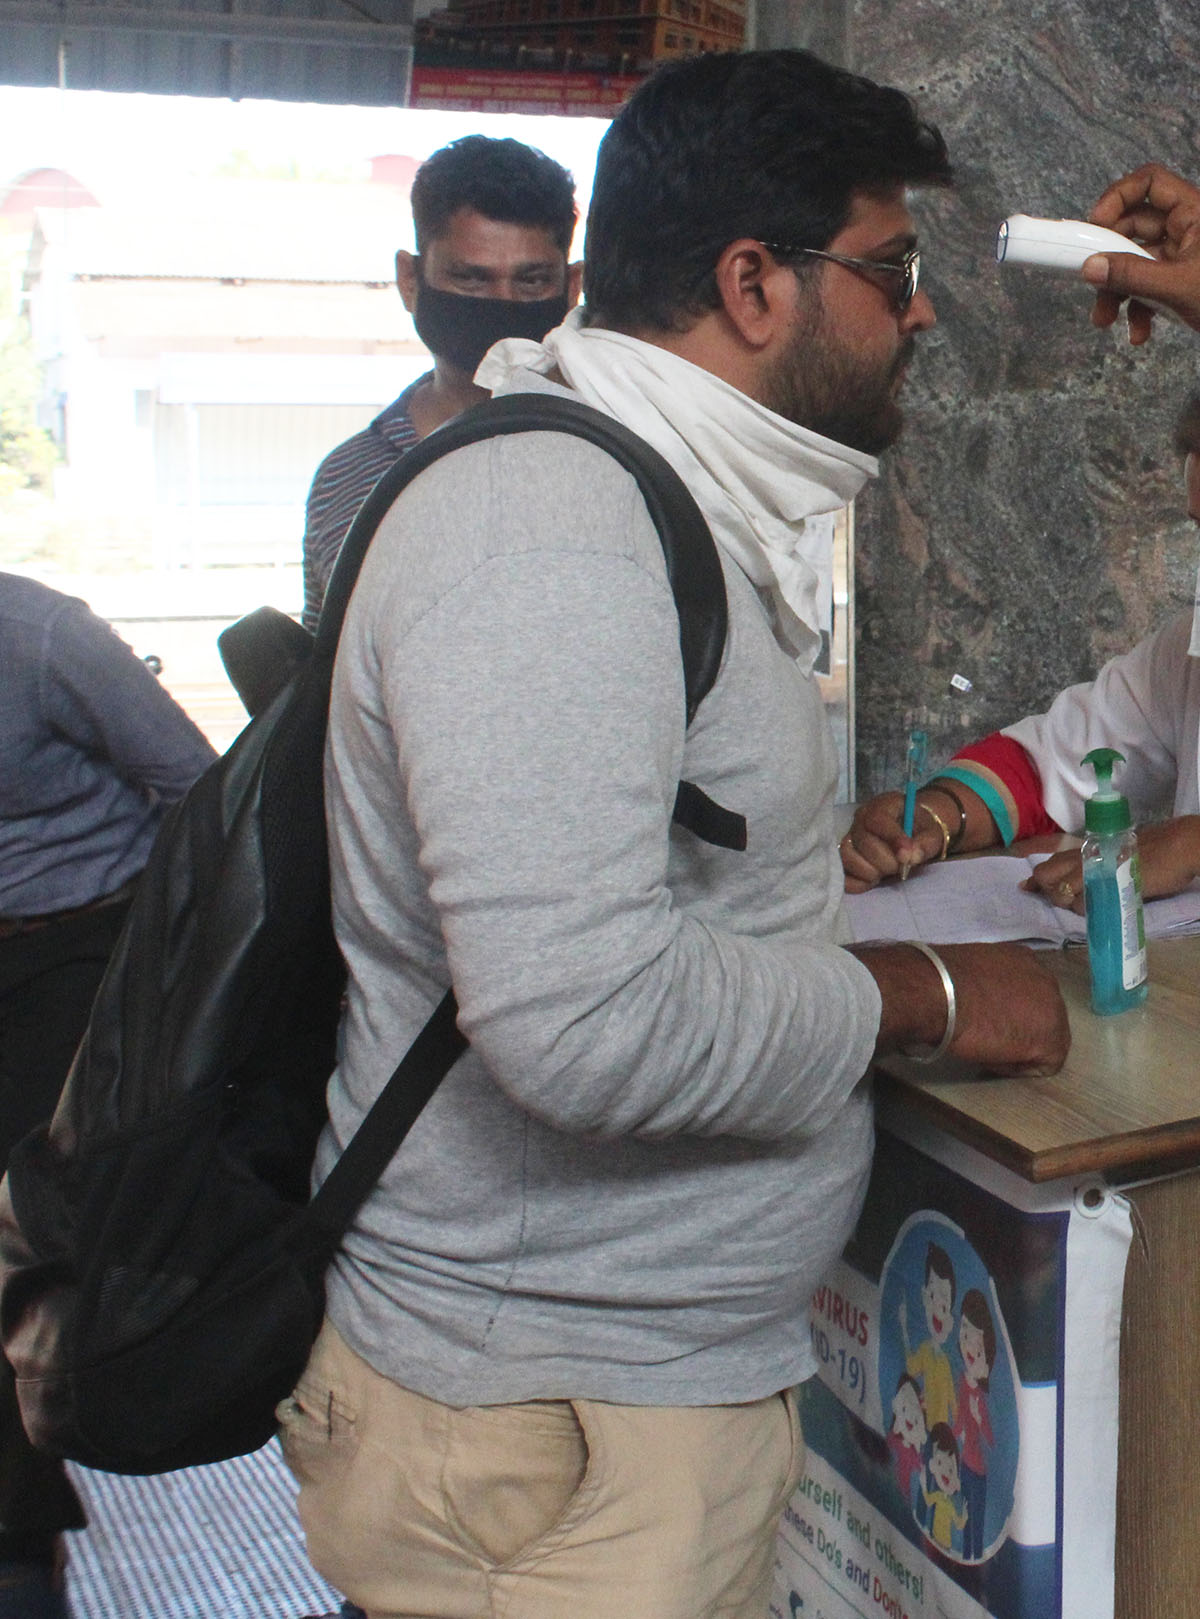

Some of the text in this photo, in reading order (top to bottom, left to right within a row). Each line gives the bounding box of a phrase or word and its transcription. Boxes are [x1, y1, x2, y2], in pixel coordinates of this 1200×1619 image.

[817, 1527, 843, 1570] Do's
[845, 1557, 871, 1594] and
[847, 1510, 871, 1550] and
[874, 1538, 924, 1605] others!
